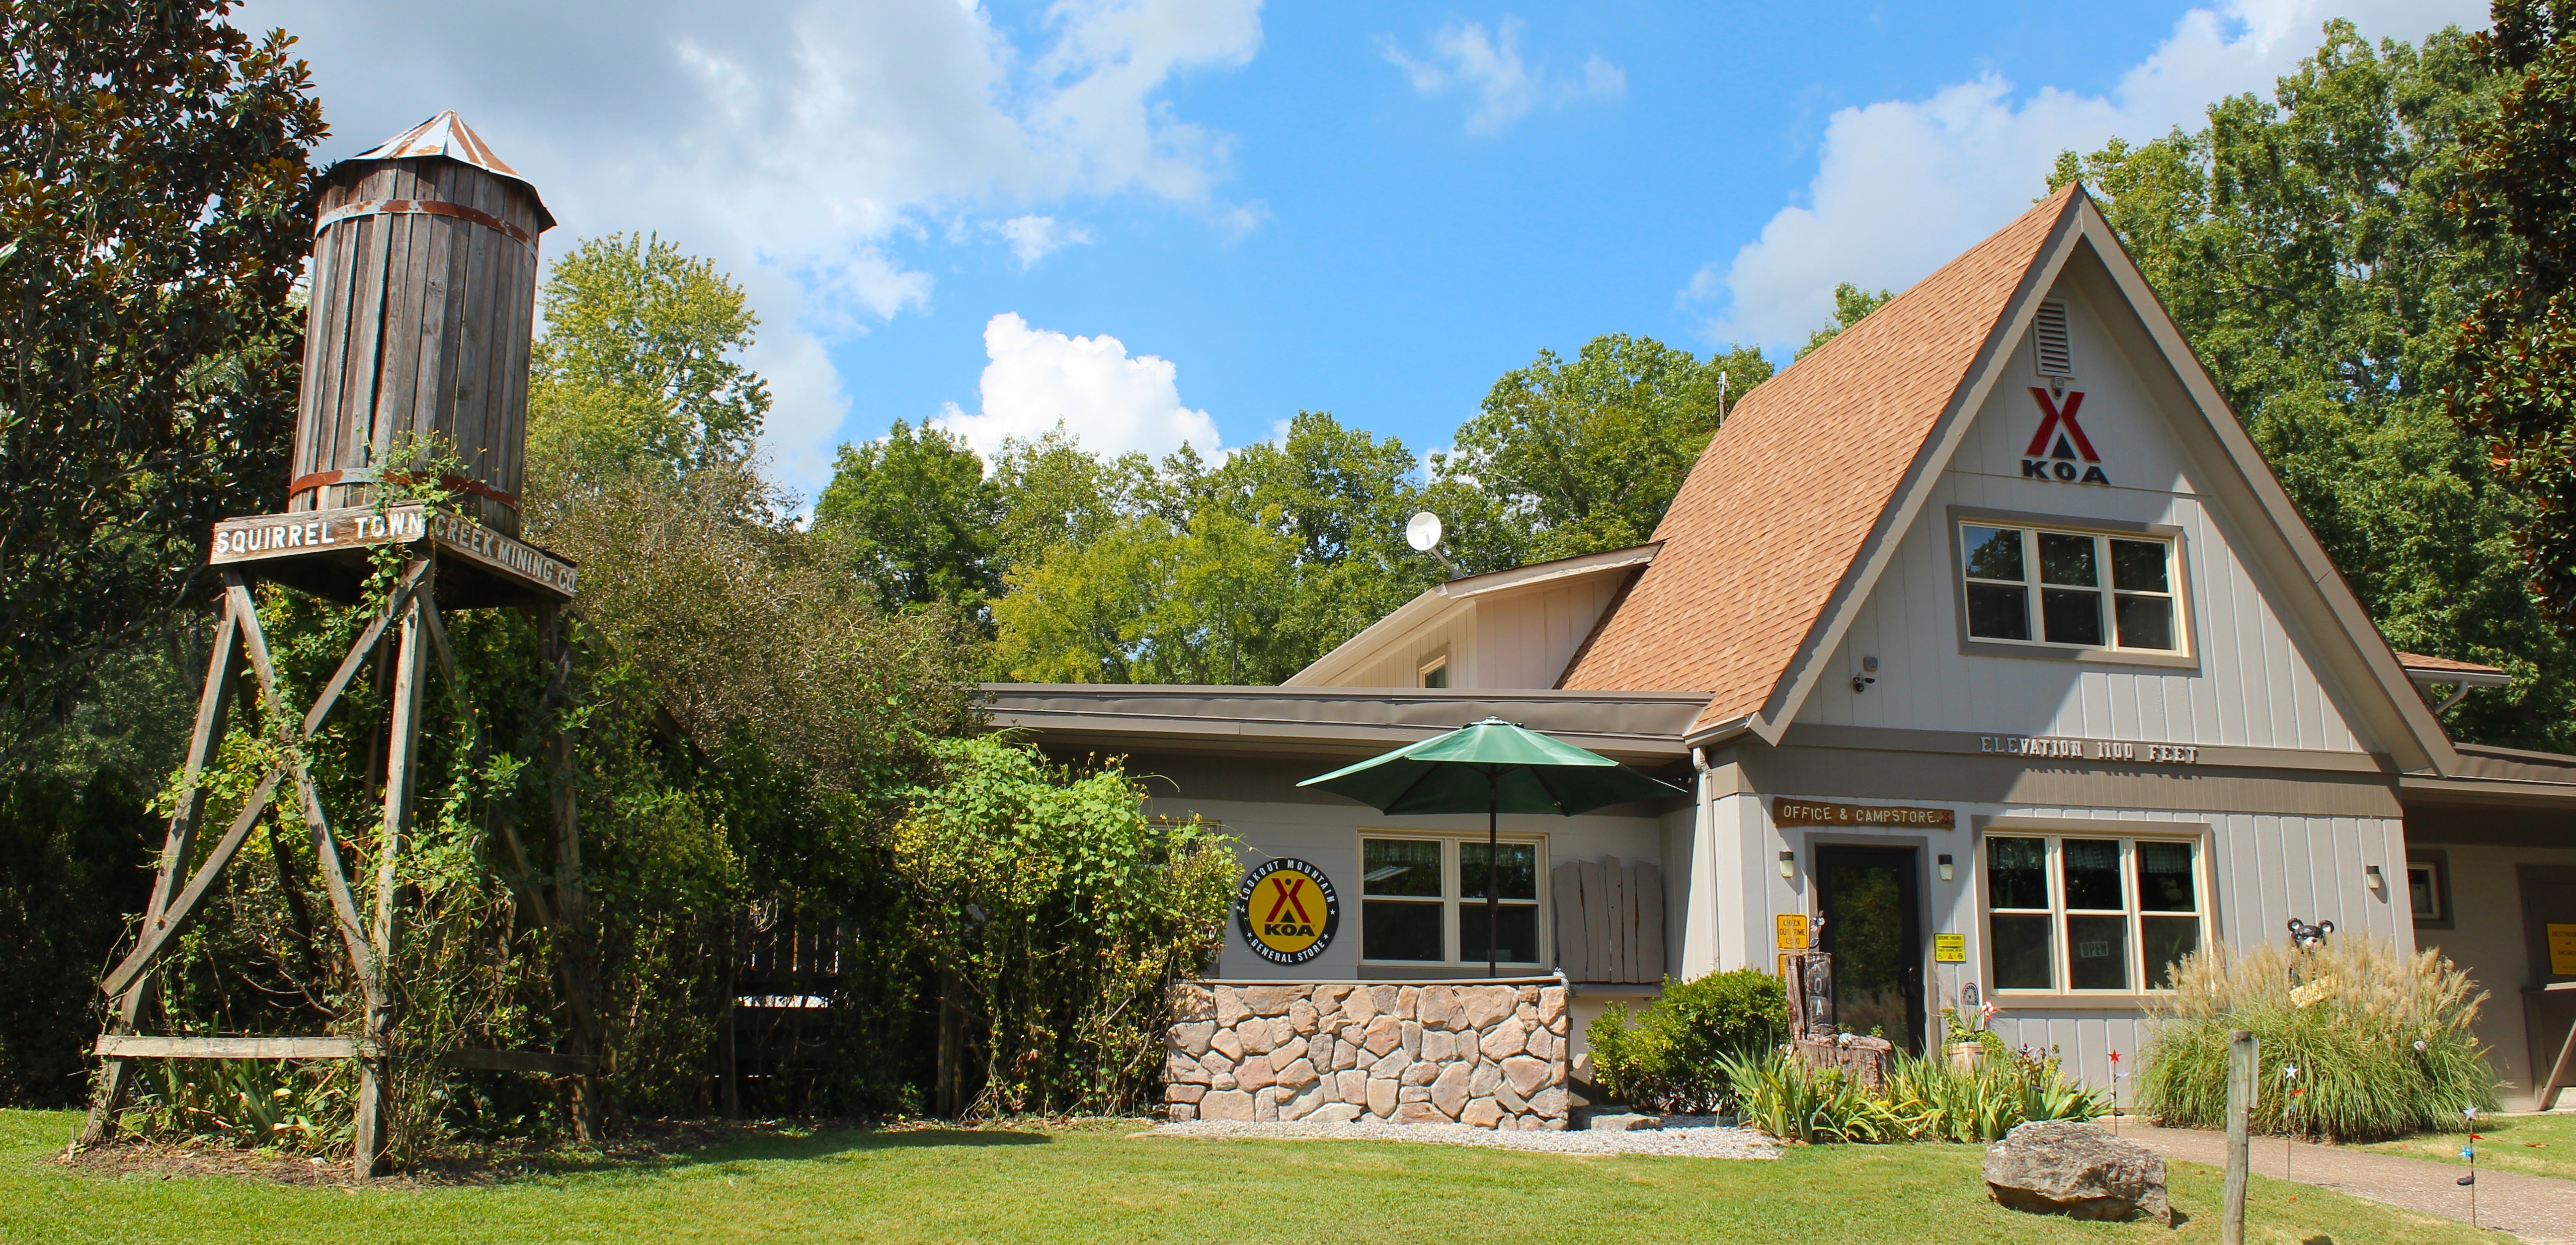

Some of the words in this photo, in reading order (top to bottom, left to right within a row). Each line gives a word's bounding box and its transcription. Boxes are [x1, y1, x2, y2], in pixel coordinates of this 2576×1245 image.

[2021, 460, 2111, 486] KOA
[217, 522, 335, 553] SQUIRREL
[354, 512, 424, 538] TOWN
[435, 514, 494, 557] CREEK
[497, 540, 553, 581] MINING
[1980, 737, 2083, 757] ELEVATION
[2096, 742, 2134, 759] 1100
[2149, 745, 2198, 763] FEET
[1784, 806, 1832, 820] OFFICE
[1840, 808, 1848, 820] &
[1241, 860, 1279, 901] LOOKOUT
[1287, 860, 1335, 903] MOUNTAIN
[1264, 923, 1316, 937] KOA
[1251, 939, 1293, 963] GENERAL
[1297, 940, 1325, 961] STORE
[2082, 942, 2107, 956] OPEN
